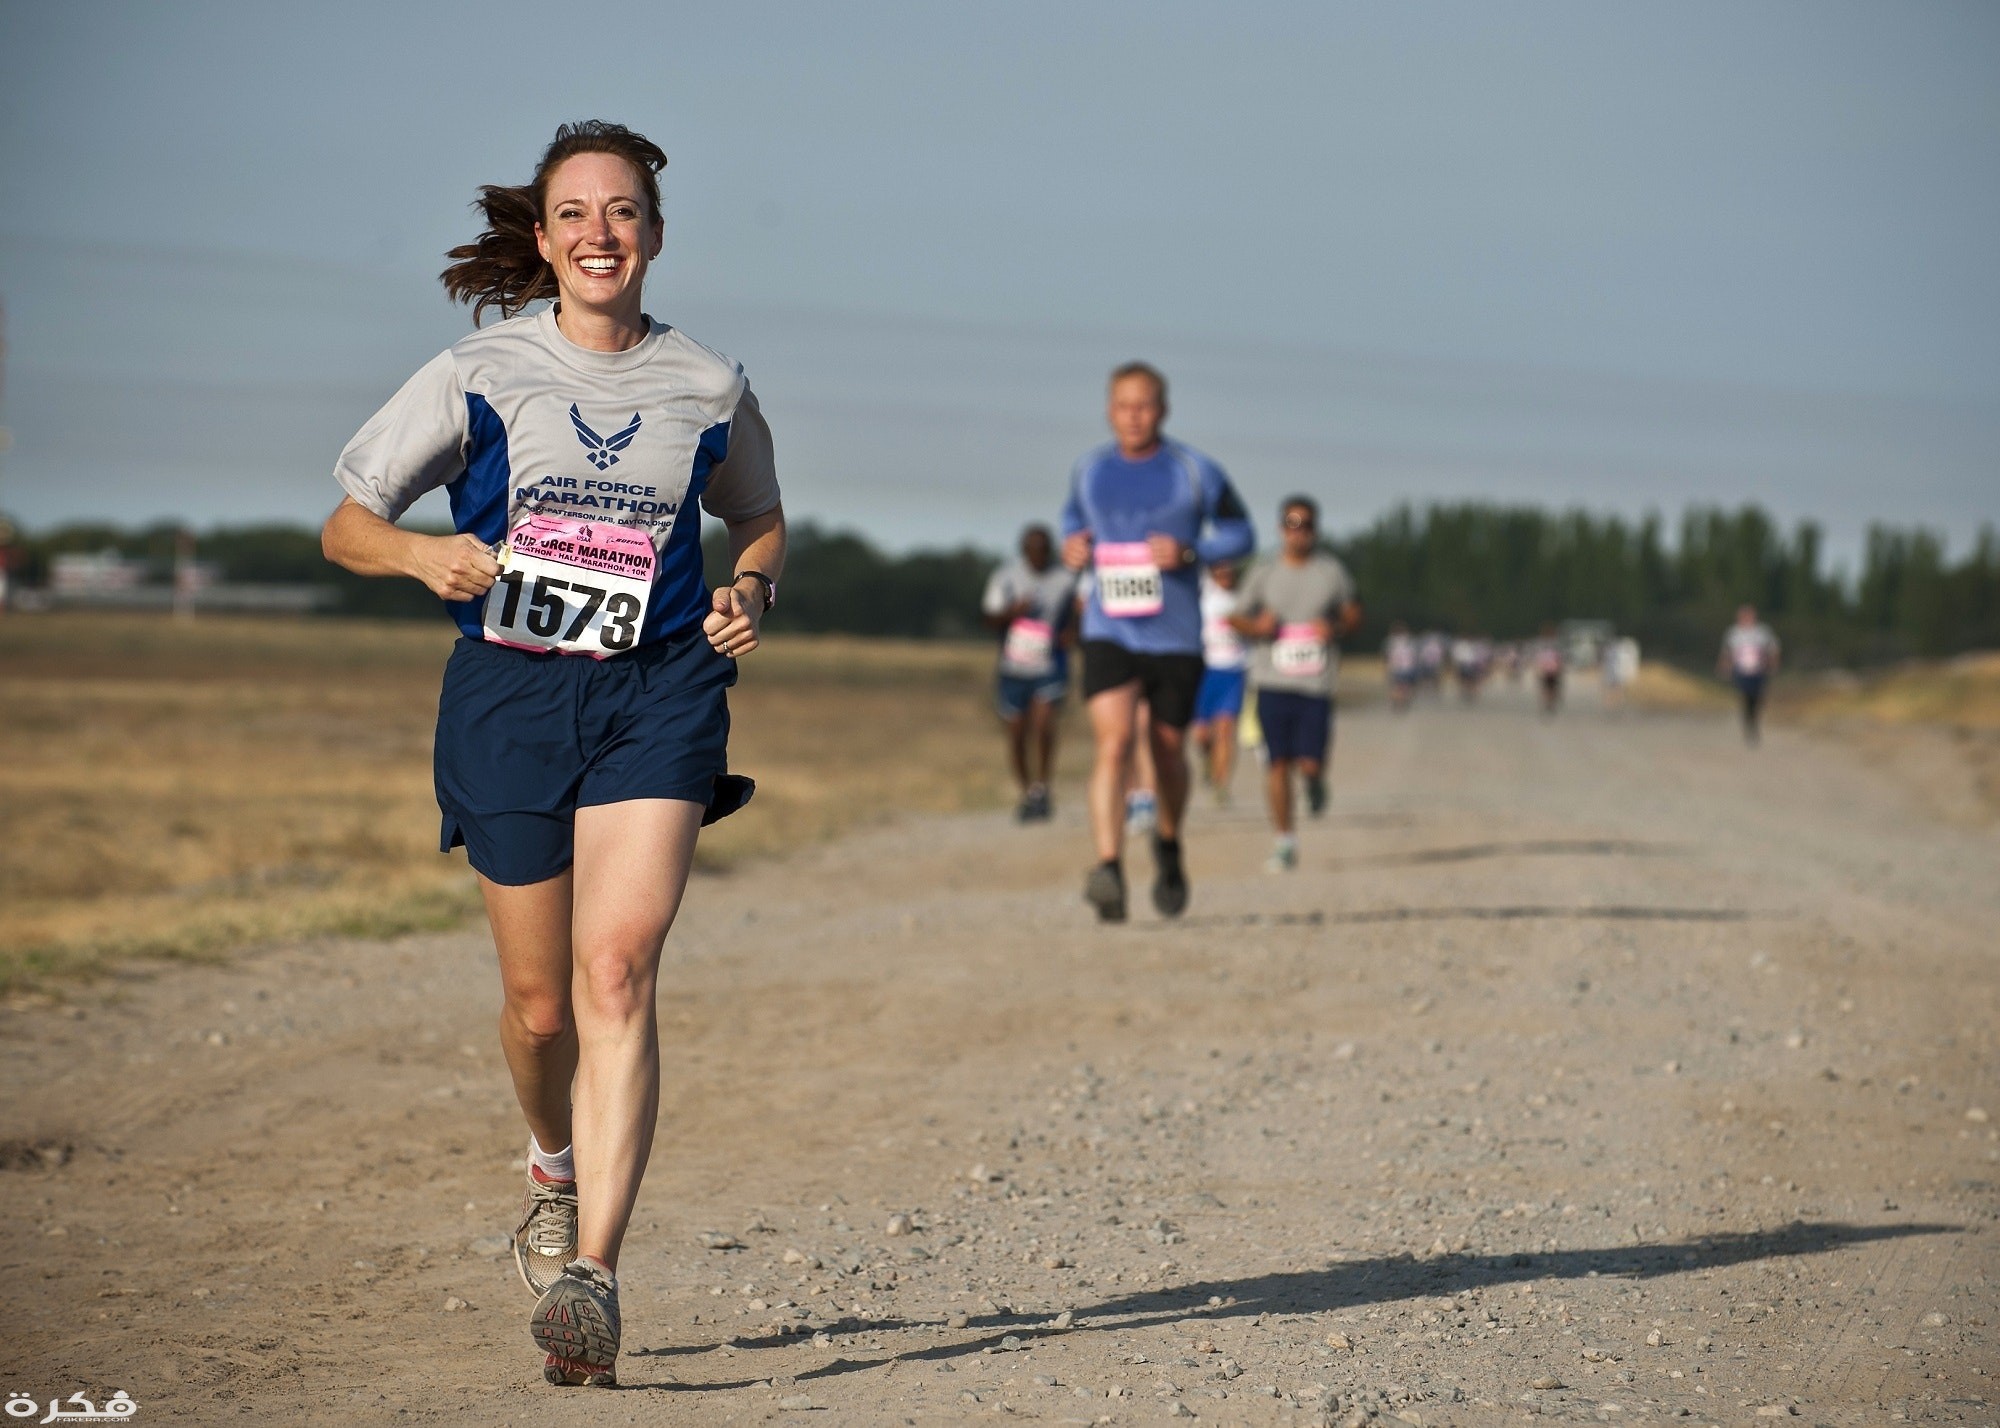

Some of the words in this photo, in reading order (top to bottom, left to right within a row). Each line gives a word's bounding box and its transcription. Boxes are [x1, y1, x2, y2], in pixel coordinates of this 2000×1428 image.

[516, 487, 677, 515] MARATHON
[540, 475, 578, 489] AIR
[585, 480, 657, 497] FORCE
[513, 532, 537, 546] AIR
[539, 539, 575, 553] ORCE
[577, 545, 653, 569] MARATHON
[513, 545, 553, 557] MATHON
[558, 552, 579, 562] HALF
[580, 557, 626, 572] MARATHON
[631, 568, 647, 577] 10K
[500, 569, 641, 650] 1573
